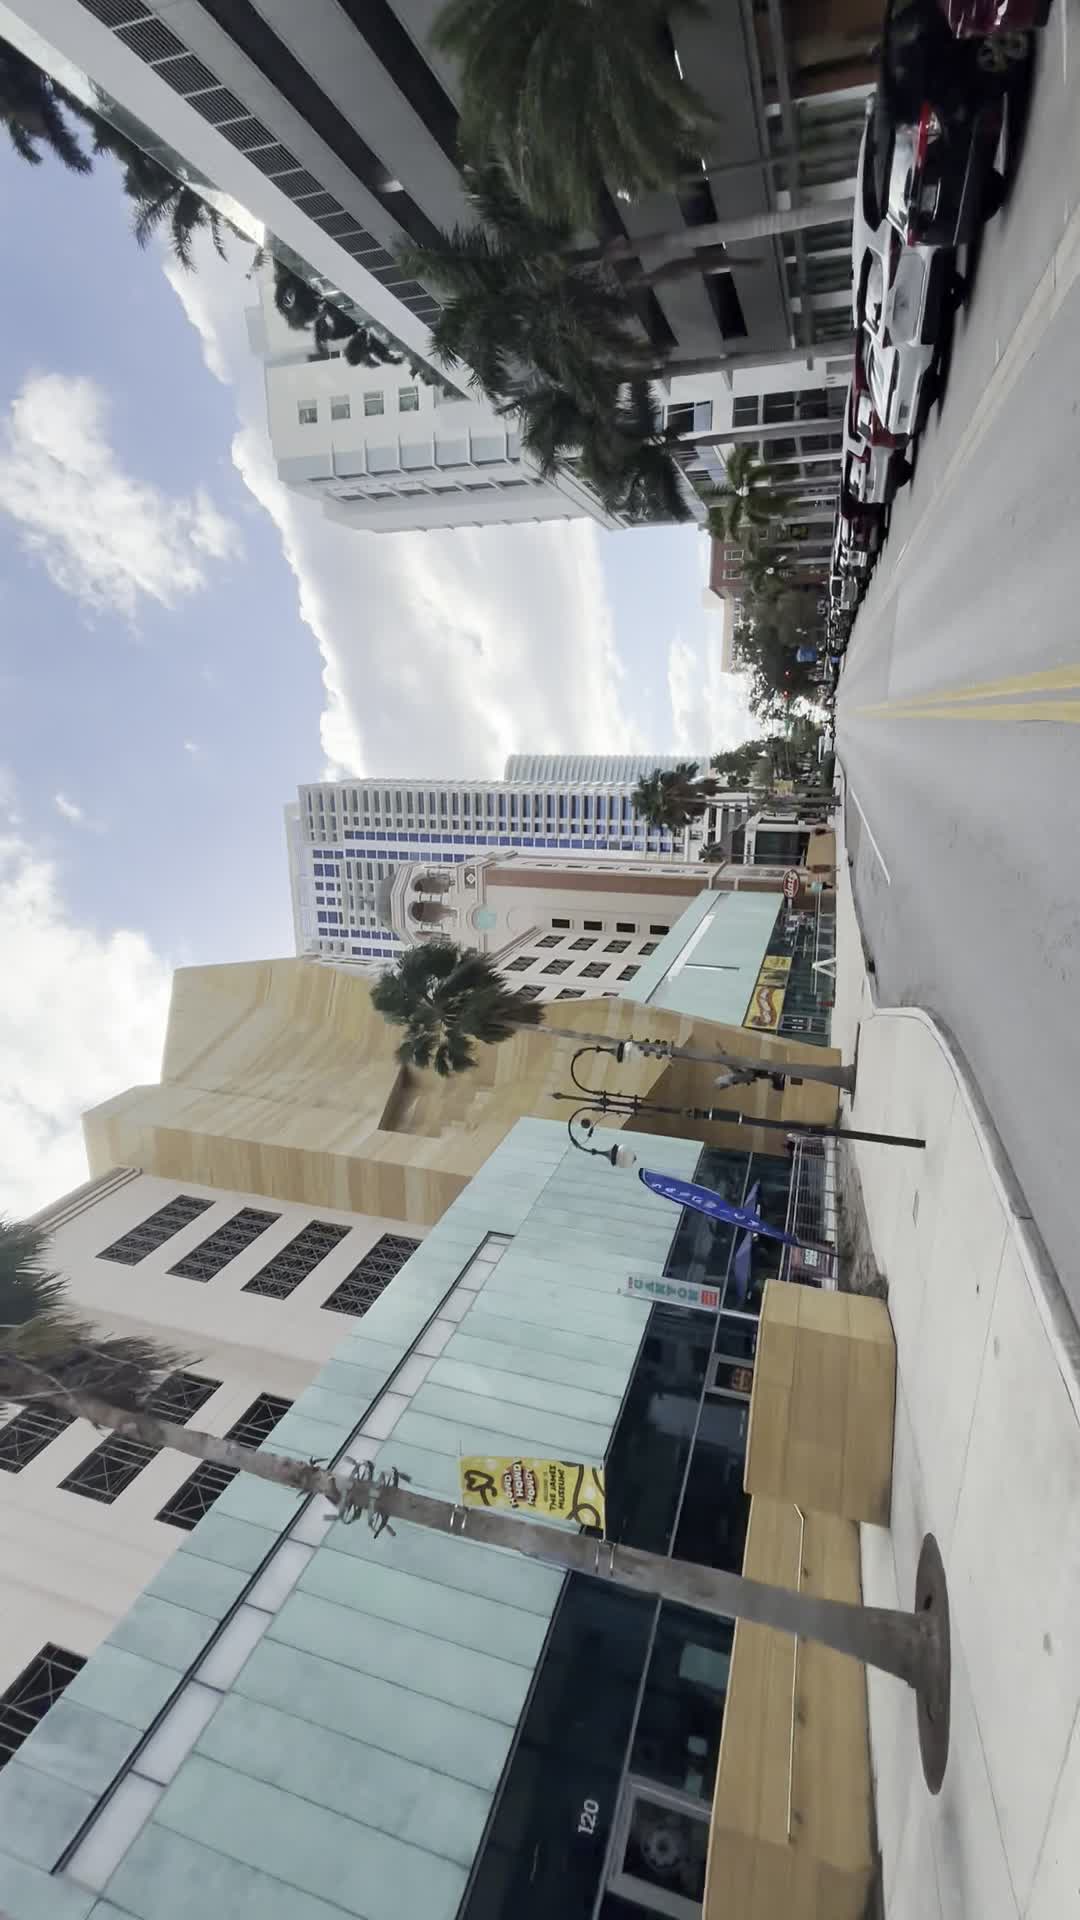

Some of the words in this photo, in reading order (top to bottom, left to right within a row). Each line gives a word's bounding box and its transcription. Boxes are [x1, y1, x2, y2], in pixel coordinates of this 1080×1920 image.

[504, 1469, 517, 1506] HOWDY
[549, 1464, 557, 1491] JAMES
[549, 1493, 557, 1511] THE
[578, 1799, 599, 1834] 120
